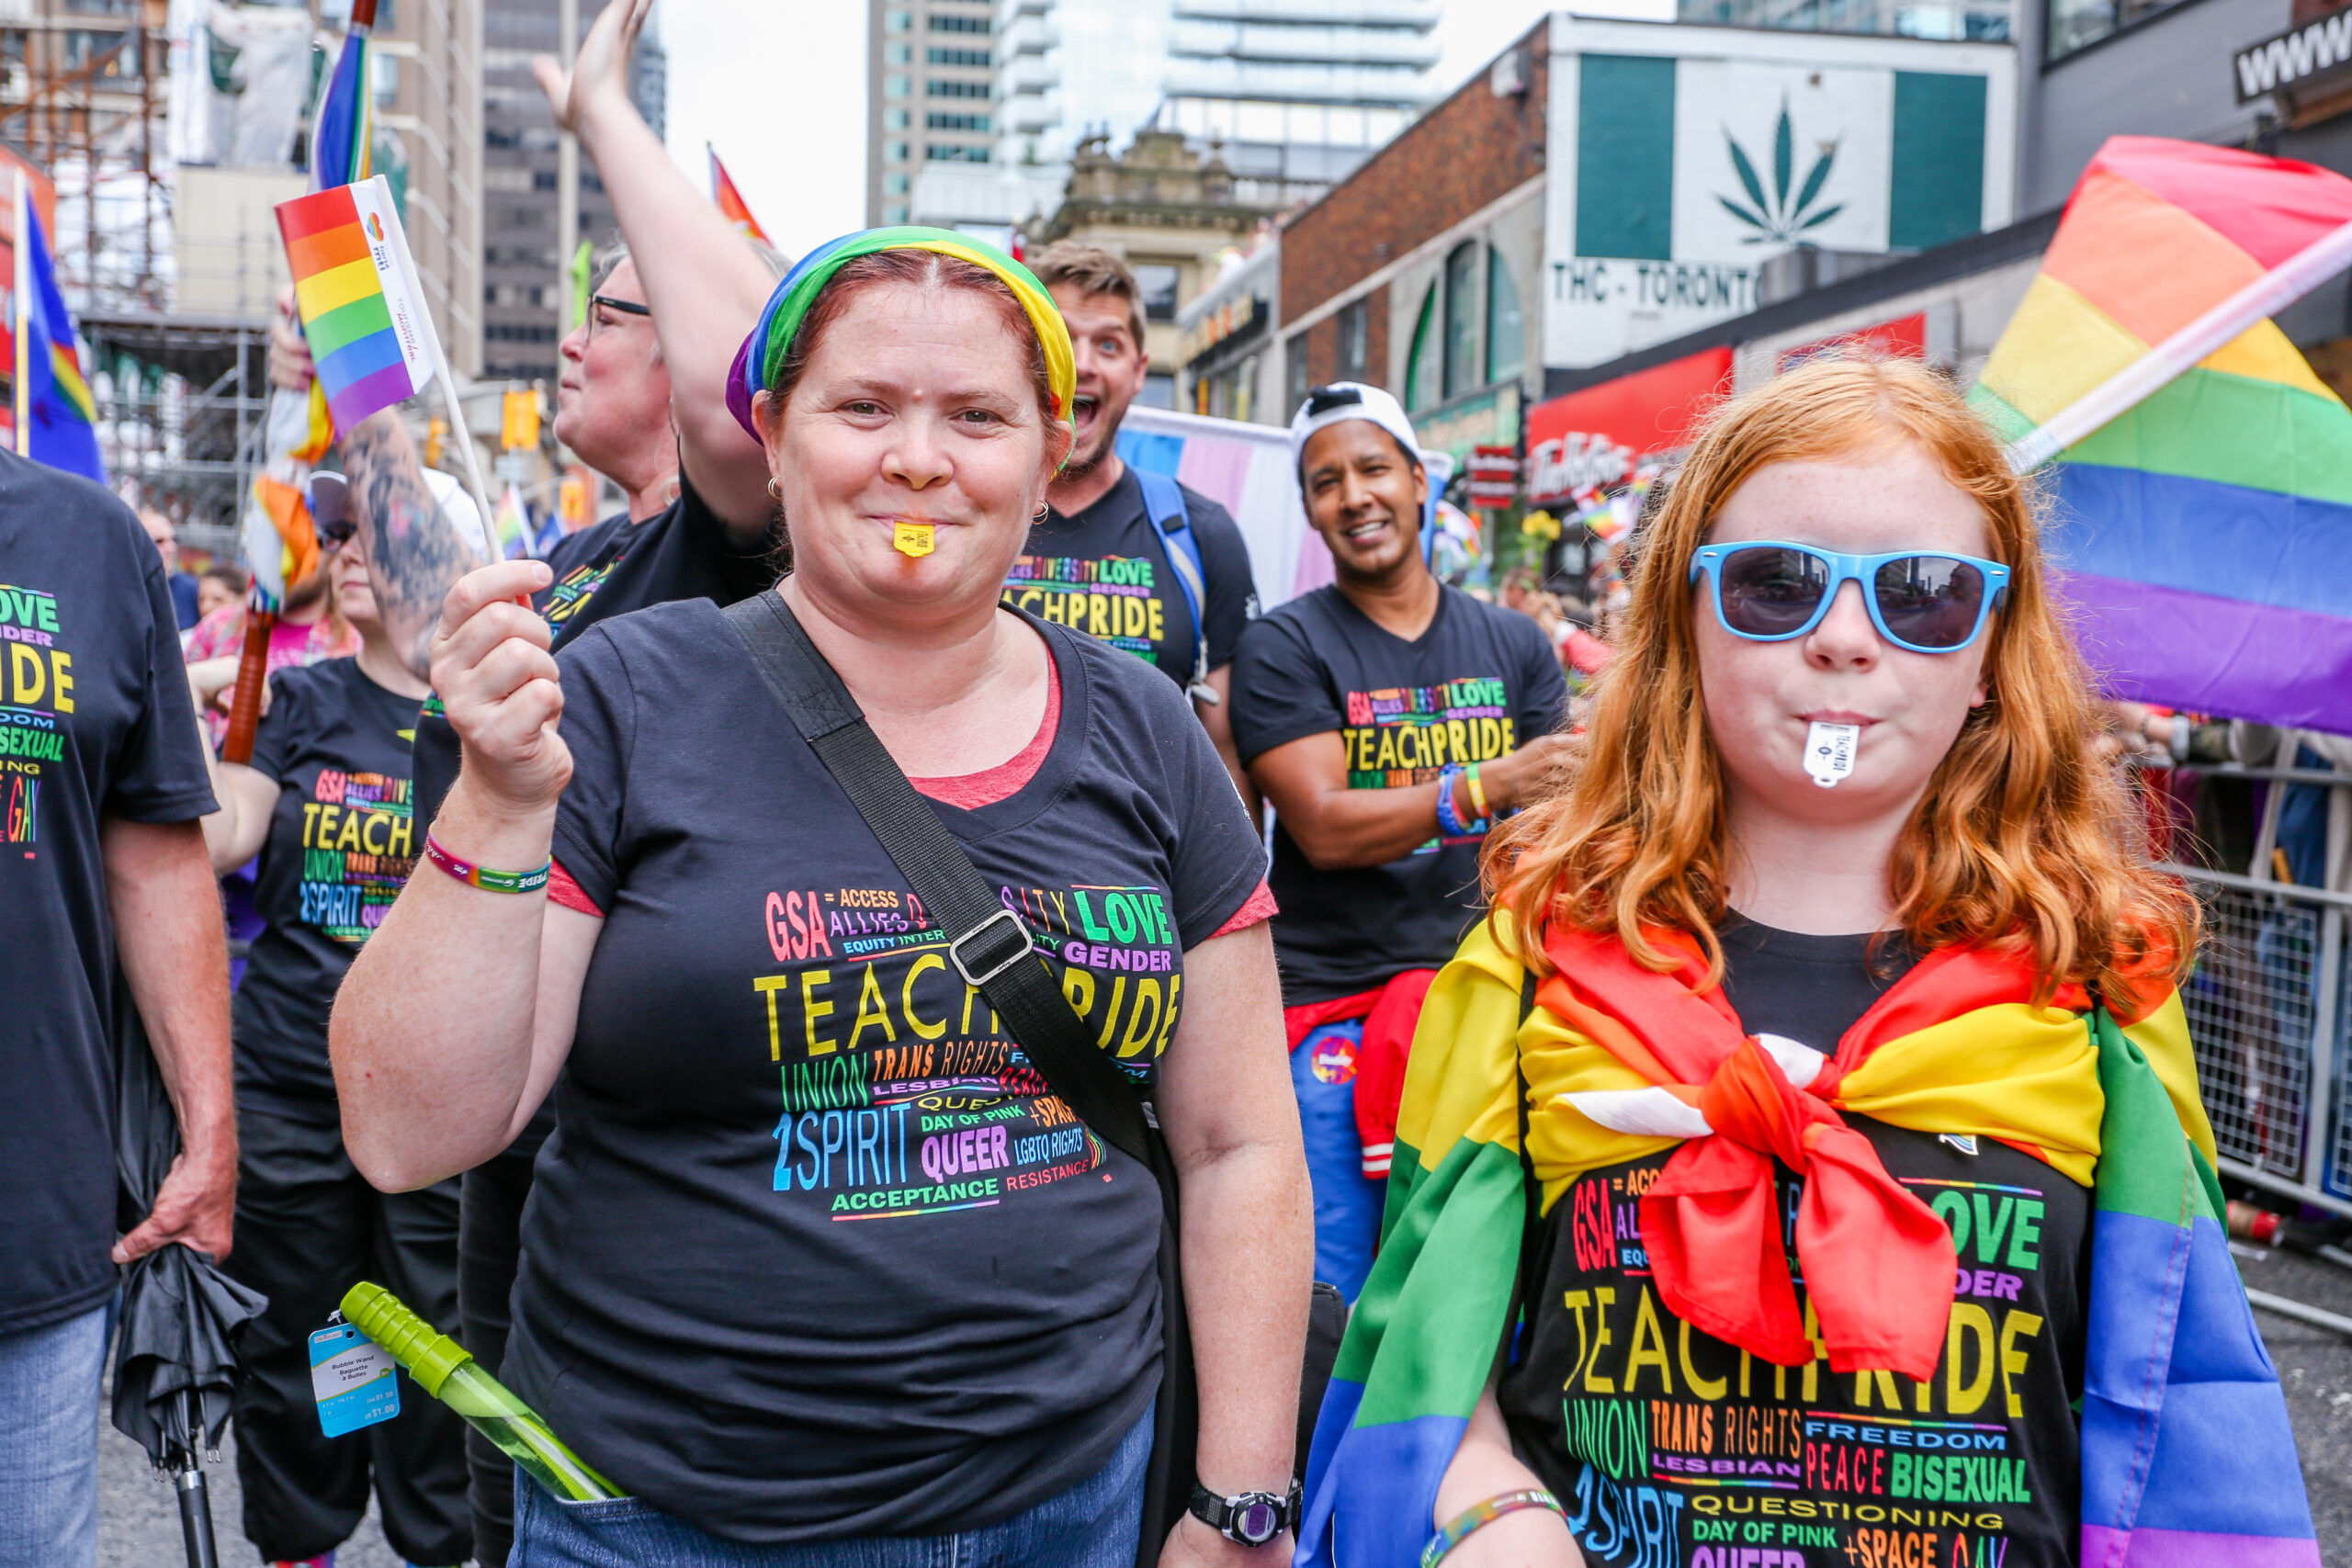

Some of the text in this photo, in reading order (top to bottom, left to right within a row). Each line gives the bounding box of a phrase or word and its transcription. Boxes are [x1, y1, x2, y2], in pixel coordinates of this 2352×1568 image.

[1553, 263, 1607, 302] THC
[1638, 265, 1759, 306] TORONT
[1099, 559, 1155, 588] LOVE
[1451, 680, 1507, 707] LOVE
[1343, 717, 1516, 771] TEACHPRIDE
[7, 775, 41, 842] GAY
[302, 803, 413, 858] TEACH
[300, 881, 362, 926] 2SPIRIT
[518, 871, 548, 888] PRIDE
[765, 890, 833, 962] GSA
[840, 888, 899, 908] ACCESS
[830, 911, 910, 937] ALLIES
[1073, 890, 1173, 944] LOVE
[842, 937, 896, 953] EQUITY
[1064, 942, 1171, 972] GENDER
[781, 1041, 1008, 1112] UNION TRANS RIGHTS
[772, 1102, 911, 1191] 2SPIRIT
[921, 1115, 955, 1133] DAY
[958, 1113, 981, 1126] OF
[984, 1105, 1027, 1122] PINK
[921, 1124, 1011, 1183] QUEER
[1014, 1134, 1050, 1166] LGBTQ
[1052, 1127, 1083, 1157] RIGHTS
[831, 1159, 1089, 1212] ACCEPTANCE RESISTANCE
[1573, 1179, 1617, 1272] GSA
[1931, 1190, 2045, 1270] OVE
[1953, 1269, 2023, 1302] DER
[332, 1355, 375, 1370] Bubble Wand
[339, 1365, 368, 1375] Baguette
[1563, 1400, 2007, 1481] UNION TRANS RIGHTS FREEDOM
[1653, 1442, 2031, 1503] LESBIAN PEACE BISEXUAL
[1691, 1495, 2004, 1529] QUESTIONING
[1692, 1519, 1738, 1541] DAY
[1743, 1521, 1776, 1543] OF
[1781, 1522, 1838, 1549] PINK
